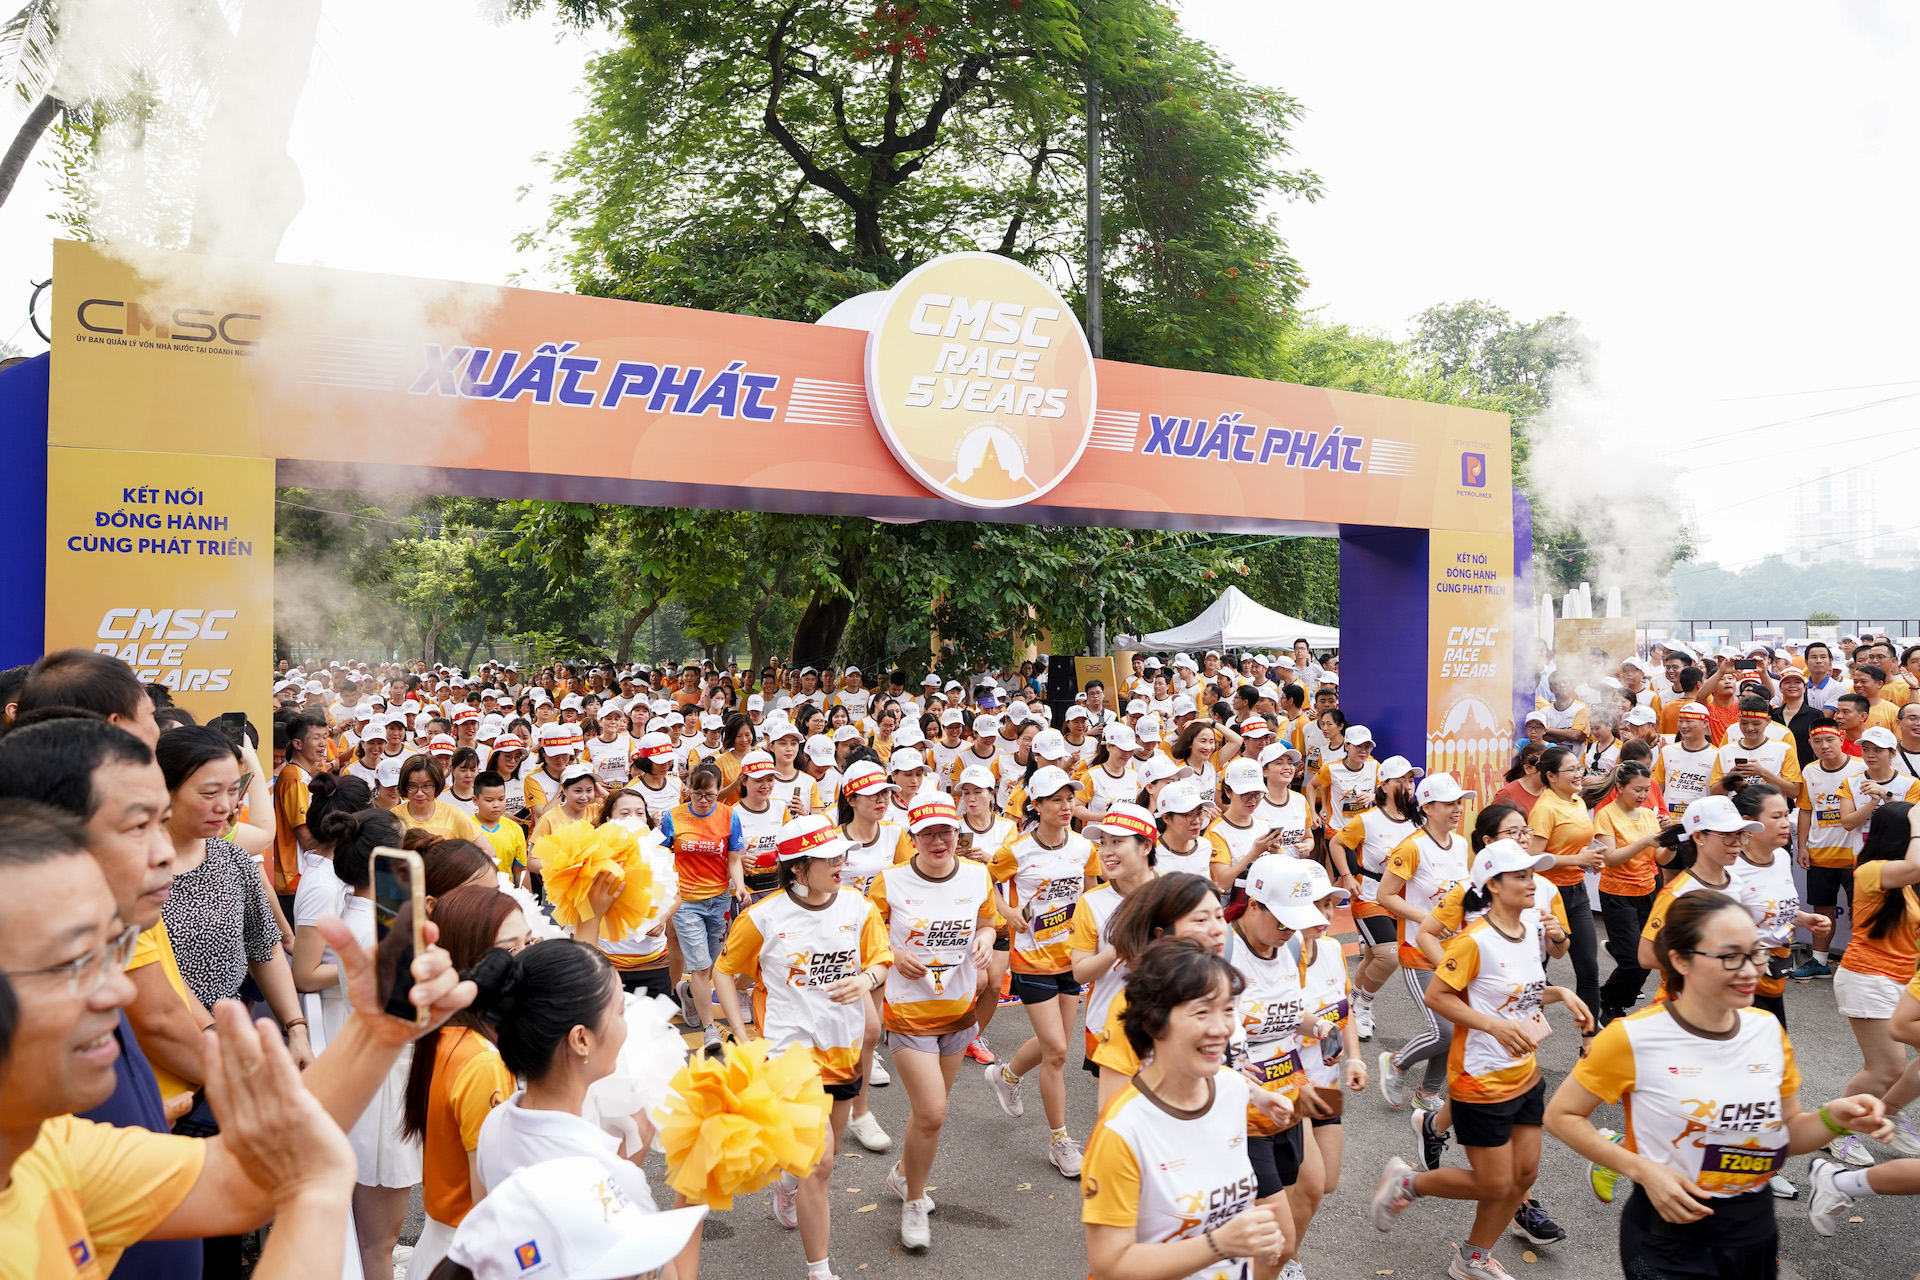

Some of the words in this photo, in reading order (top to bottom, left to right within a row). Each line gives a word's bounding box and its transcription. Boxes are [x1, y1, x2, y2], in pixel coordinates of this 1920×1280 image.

[77, 298, 261, 346] CMSC
[909, 293, 1060, 348] CMSC
[76, 334, 87, 343] ỦY
[88, 336, 105, 344] BAN
[208, 347, 233, 355] DOANH
[934, 342, 1041, 382] RACE
[408, 341, 600, 408] XUẤT
[600, 360, 780, 422] PHÁT
[904, 375, 937, 407] 5
[940, 378, 1069, 418] YEARS
[1141, 411, 1256, 463] XUẤT
[1256, 425, 1364, 474] PHÁT
[123, 485, 159, 504] KẾT
[165, 487, 203, 506] NỐI
[1456, 490, 1492, 499] PETROLIMEX
[95, 508, 161, 529] ĐỒNG
[167, 511, 228, 531] HÀNH
[67, 533, 132, 552] CÙNG
[138, 536, 191, 554] PHÁT
[196, 537, 252, 556] TRIỂN
[97, 607, 238, 640] CMSC
[1446, 626, 1499, 647] CMSC
[1443, 647, 1481, 662] RACE
[1440, 663, 1451, 678] 5
[1452, 663, 1497, 678] YEARS
[1680, 772, 1706, 782] CMSC
[922, 806, 933, 815] YÊU
[813, 833, 825, 843] TÔI
[681, 843, 696, 852] 65
[930, 919, 971, 931] CMSC
[1043, 911, 1067, 928] F2107
[927, 931, 958, 939] RACE
[936, 938, 968, 947] YEARS
[810, 964, 843, 977] RACE
[1265, 1060, 1293, 1079] F2064
[1720, 1154, 1773, 1171] F2081
